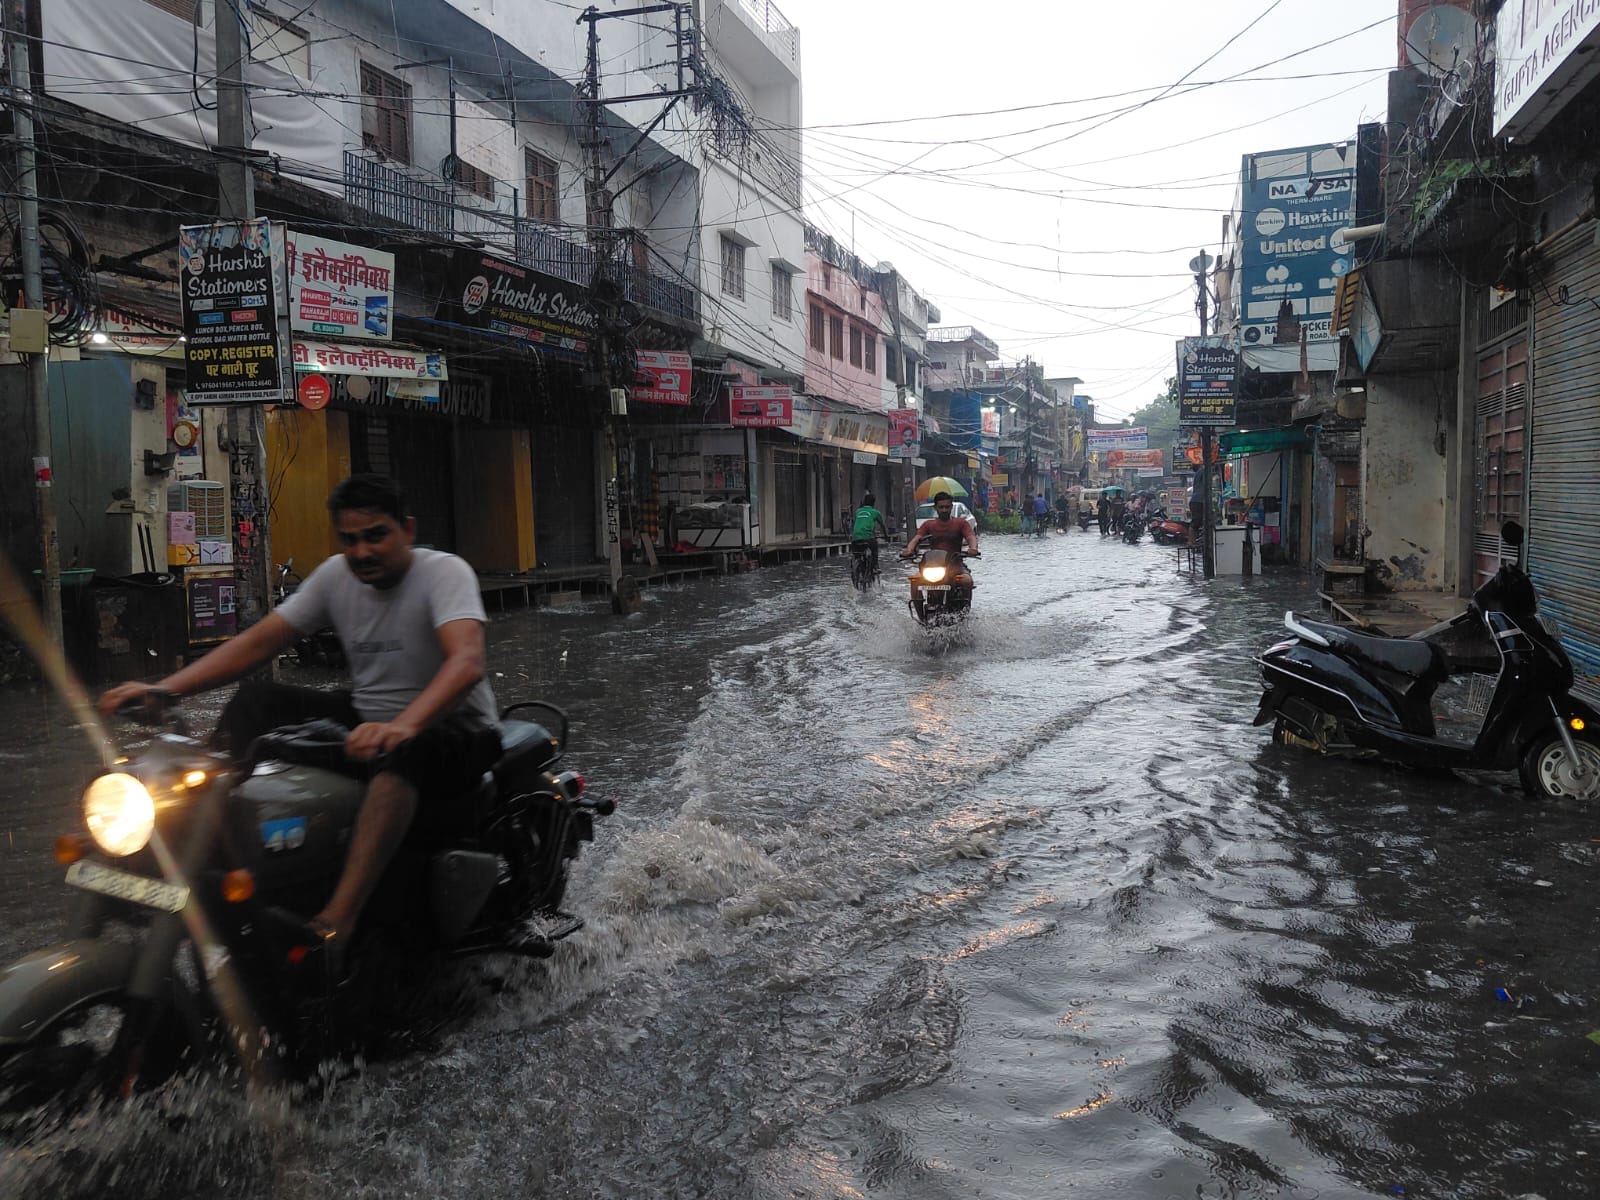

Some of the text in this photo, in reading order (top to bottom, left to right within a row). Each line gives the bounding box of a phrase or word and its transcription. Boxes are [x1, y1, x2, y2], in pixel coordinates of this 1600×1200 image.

[1503, 48, 1539, 111] GUPTA
[1541, 0, 1600, 69] AGENCI
[1288, 207, 1350, 227] Hawkin
[1260, 235, 1327, 255] United
[208, 252, 266, 273] Harshit
[187, 276, 267, 297] Stationers
[491, 274, 600, 329] Harshit Station
[191, 336, 213, 345] SCHOOL
[248, 332, 271, 341] BOTTLE
[195, 326, 214, 334] LUNCH
[1199, 352, 1236, 363] Harshit
[205, 363, 219, 377] पर
[1185, 363, 1236, 375] Stationers
